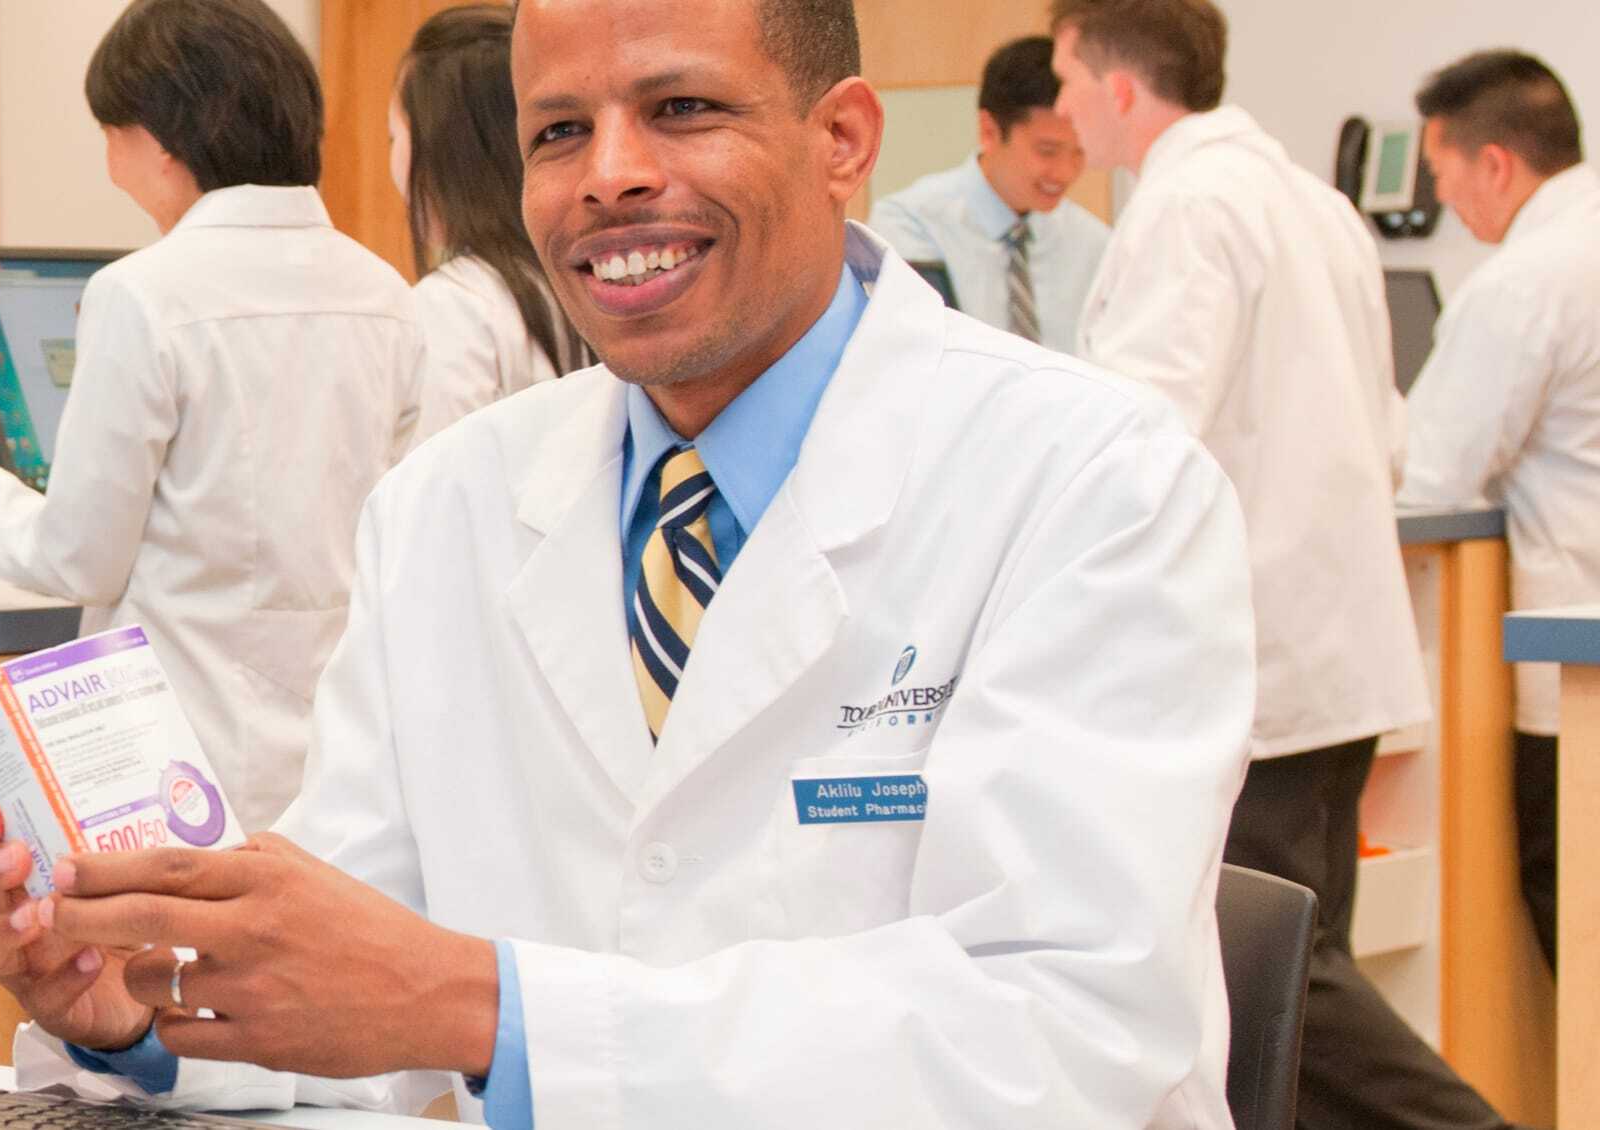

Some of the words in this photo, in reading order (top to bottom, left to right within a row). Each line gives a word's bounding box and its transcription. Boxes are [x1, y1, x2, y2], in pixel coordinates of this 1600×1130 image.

[28, 673, 106, 713] ADVAIR
[816, 783, 862, 799] Aklilu
[871, 780, 927, 799] Joseph
[807, 805, 859, 818] Student
